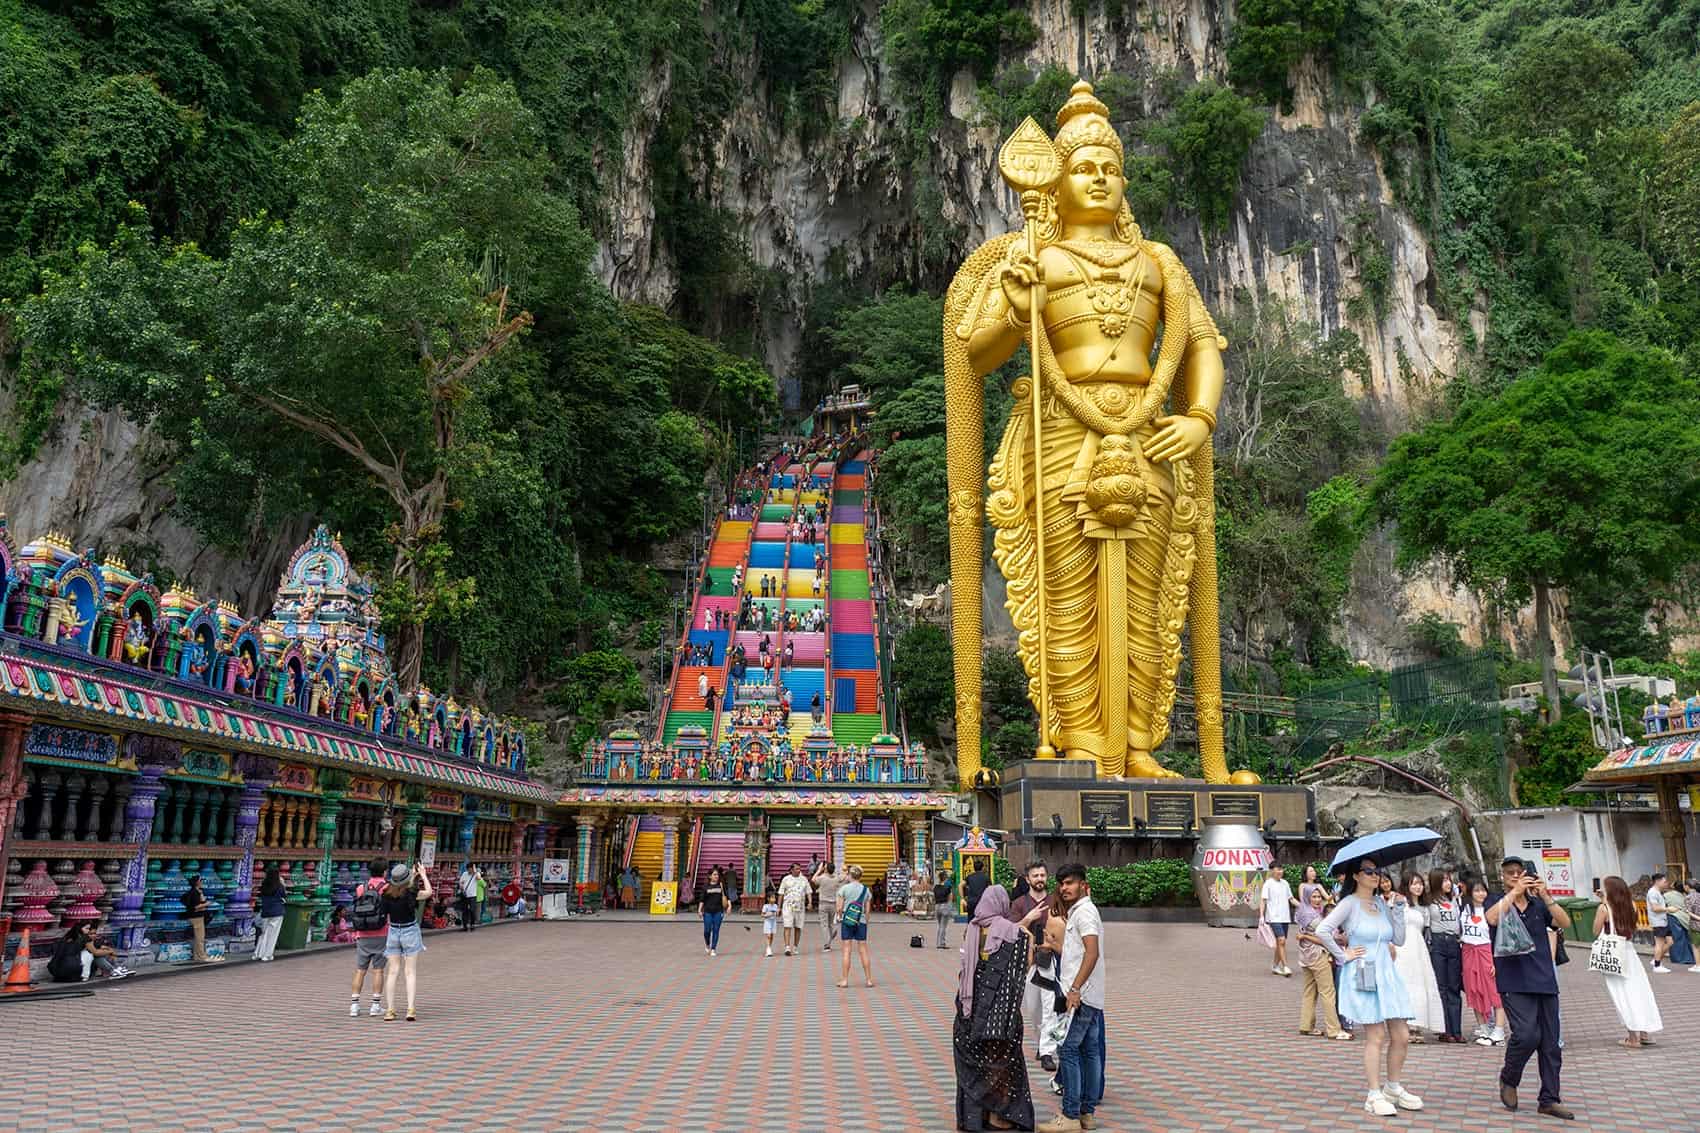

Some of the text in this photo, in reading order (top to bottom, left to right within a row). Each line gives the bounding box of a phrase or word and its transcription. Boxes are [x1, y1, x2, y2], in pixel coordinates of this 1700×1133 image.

[1203, 848, 1266, 866] DONAT
[1440, 911, 1456, 921] KL
[1464, 925, 1481, 936] KL
[1591, 953, 1619, 964] FLEUR
[1591, 961, 1621, 974] MARDI
